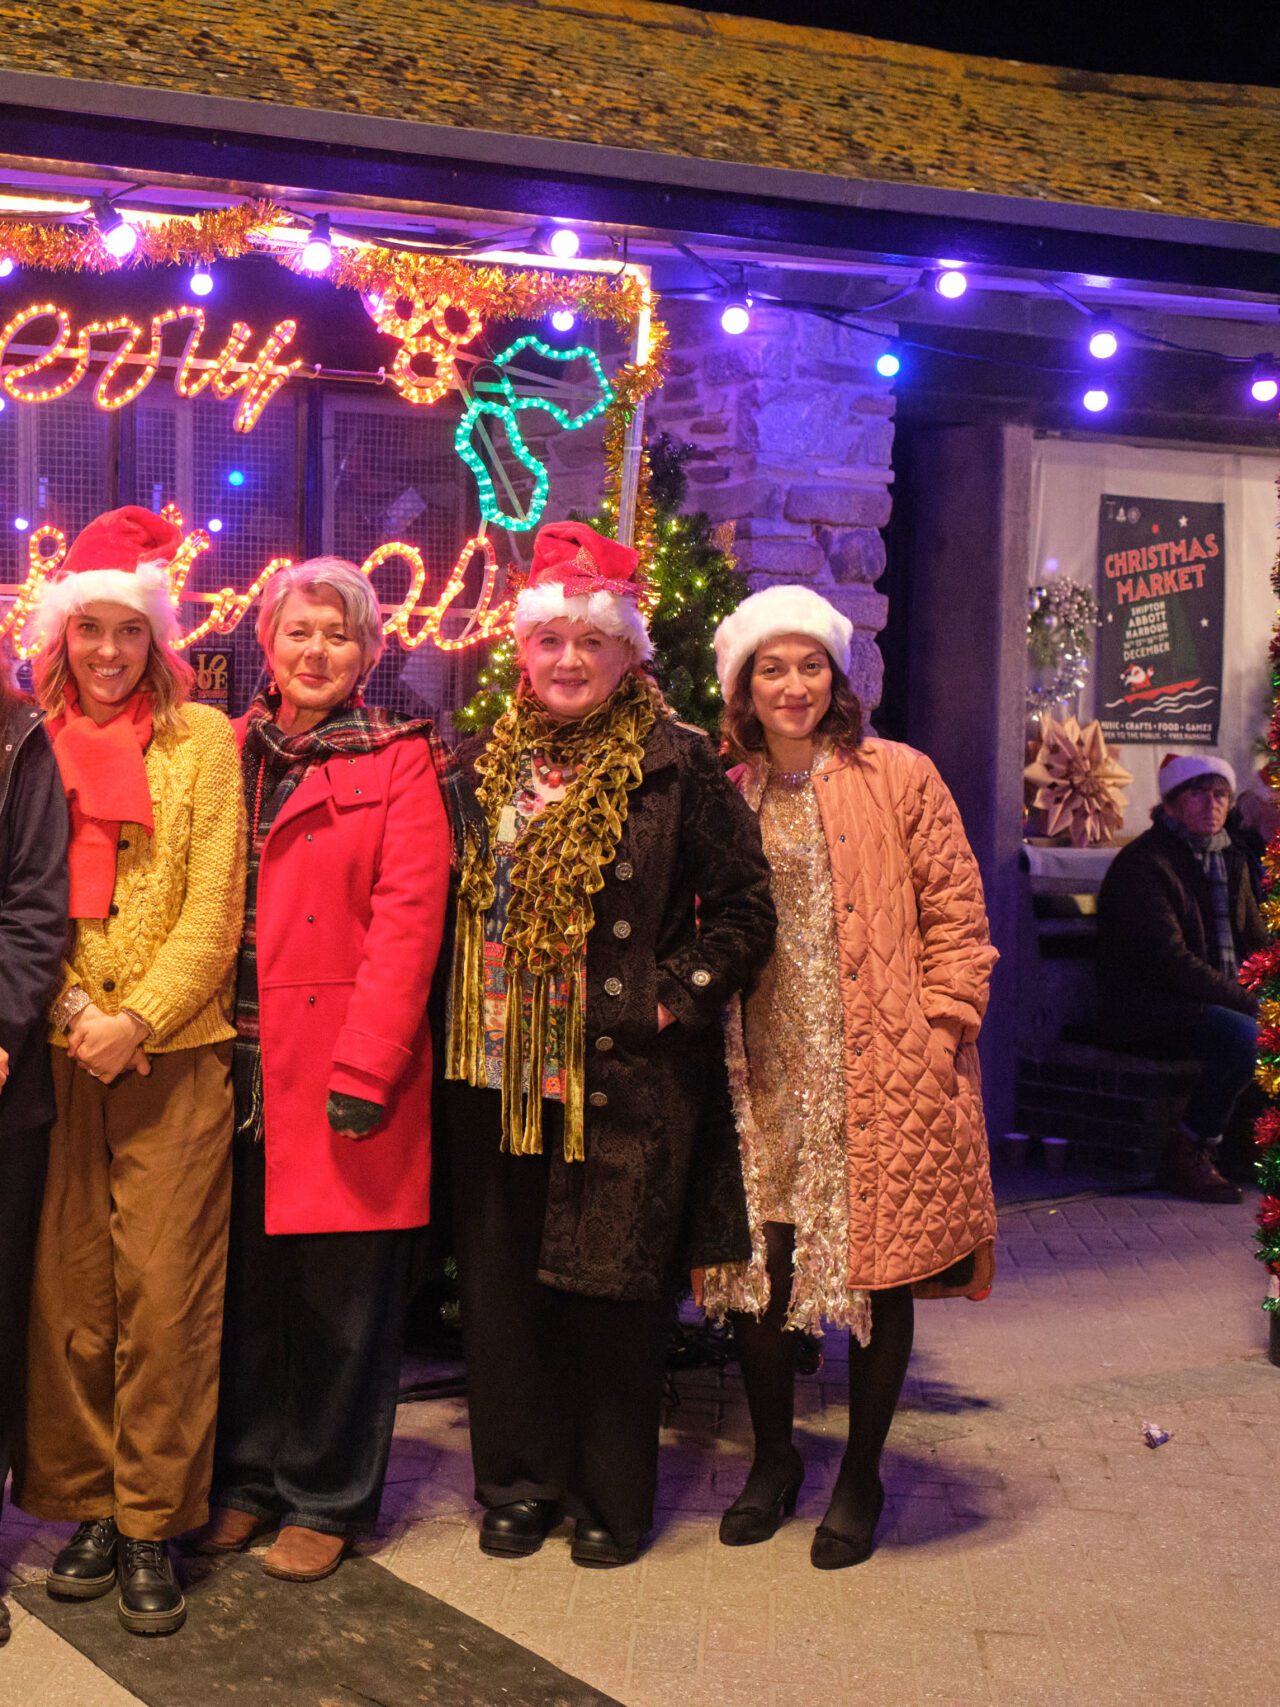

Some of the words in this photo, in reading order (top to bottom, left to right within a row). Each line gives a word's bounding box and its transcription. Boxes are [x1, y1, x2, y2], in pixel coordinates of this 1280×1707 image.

[1105, 533, 1219, 578] CHRISTMAS
[1116, 563, 1206, 605] MARKET
[1128, 611, 1167, 628] ABBOTT
[1125, 621, 1169, 639] HARBOUR
[1123, 641, 1171, 662] DECEMBER
[1125, 721, 1152, 732] CRAFTS
[1158, 722, 1180, 732] FOOD
[1185, 723, 1213, 732] GAMES
